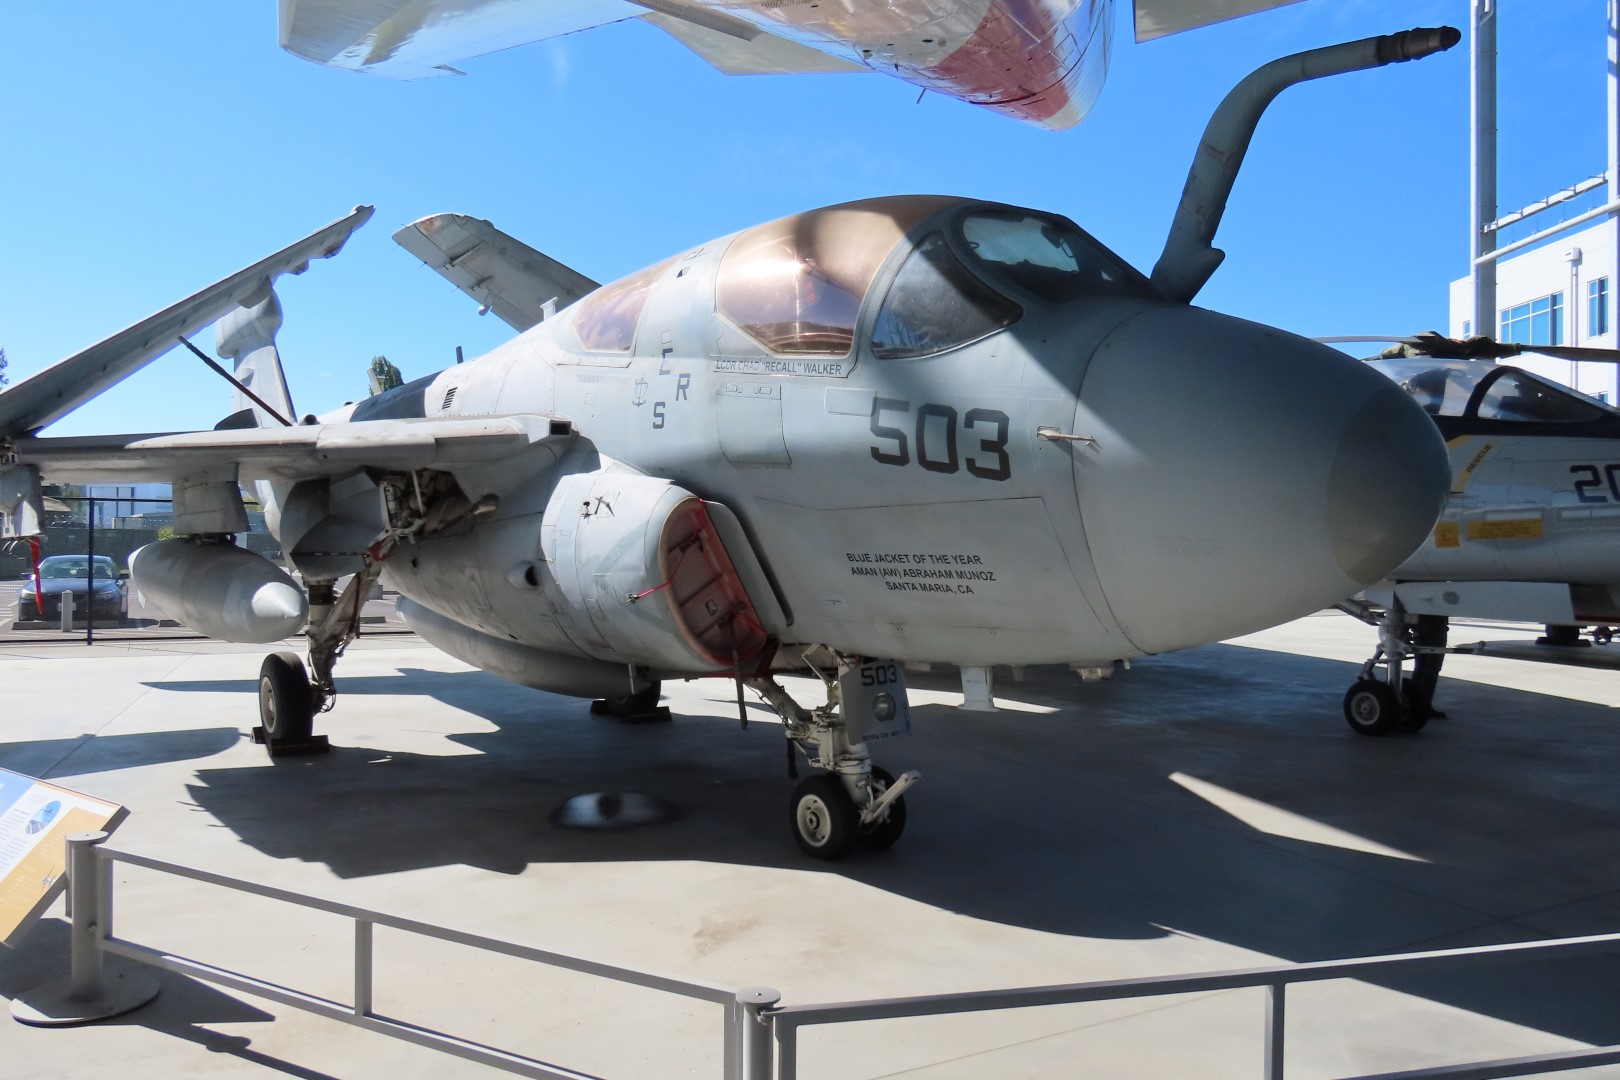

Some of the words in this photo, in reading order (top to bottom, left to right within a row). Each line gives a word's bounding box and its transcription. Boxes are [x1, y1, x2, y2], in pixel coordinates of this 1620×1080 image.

[716, 359, 737, 370] LCDR
[738, 360, 759, 371] CHAD
[761, 361, 801, 373] "RECALL"
[803, 362, 842, 375] WALKER
[675, 372, 691, 401] R
[652, 401, 666, 430] S
[870, 396, 1011, 481] 503
[1466, 443, 1494, 473] RESCUE
[846, 553, 872, 563] BLUE
[874, 553, 910, 564] JACKET
[913, 554, 927, 564] OF
[928, 554, 950, 565] THE
[951, 554, 982, 565] YEAR
[851, 566, 878, 577] AMAN
[879, 567, 901, 579] (AW)
[903, 568, 954, 579] ABRAHAM
[955, 570, 996, 581] MUNOZ
[885, 581, 918, 592] SANTA
[919, 583, 957, 594] MARIA,
[958, 584, 974, 594] CA
[861, 664, 897, 686] 503
